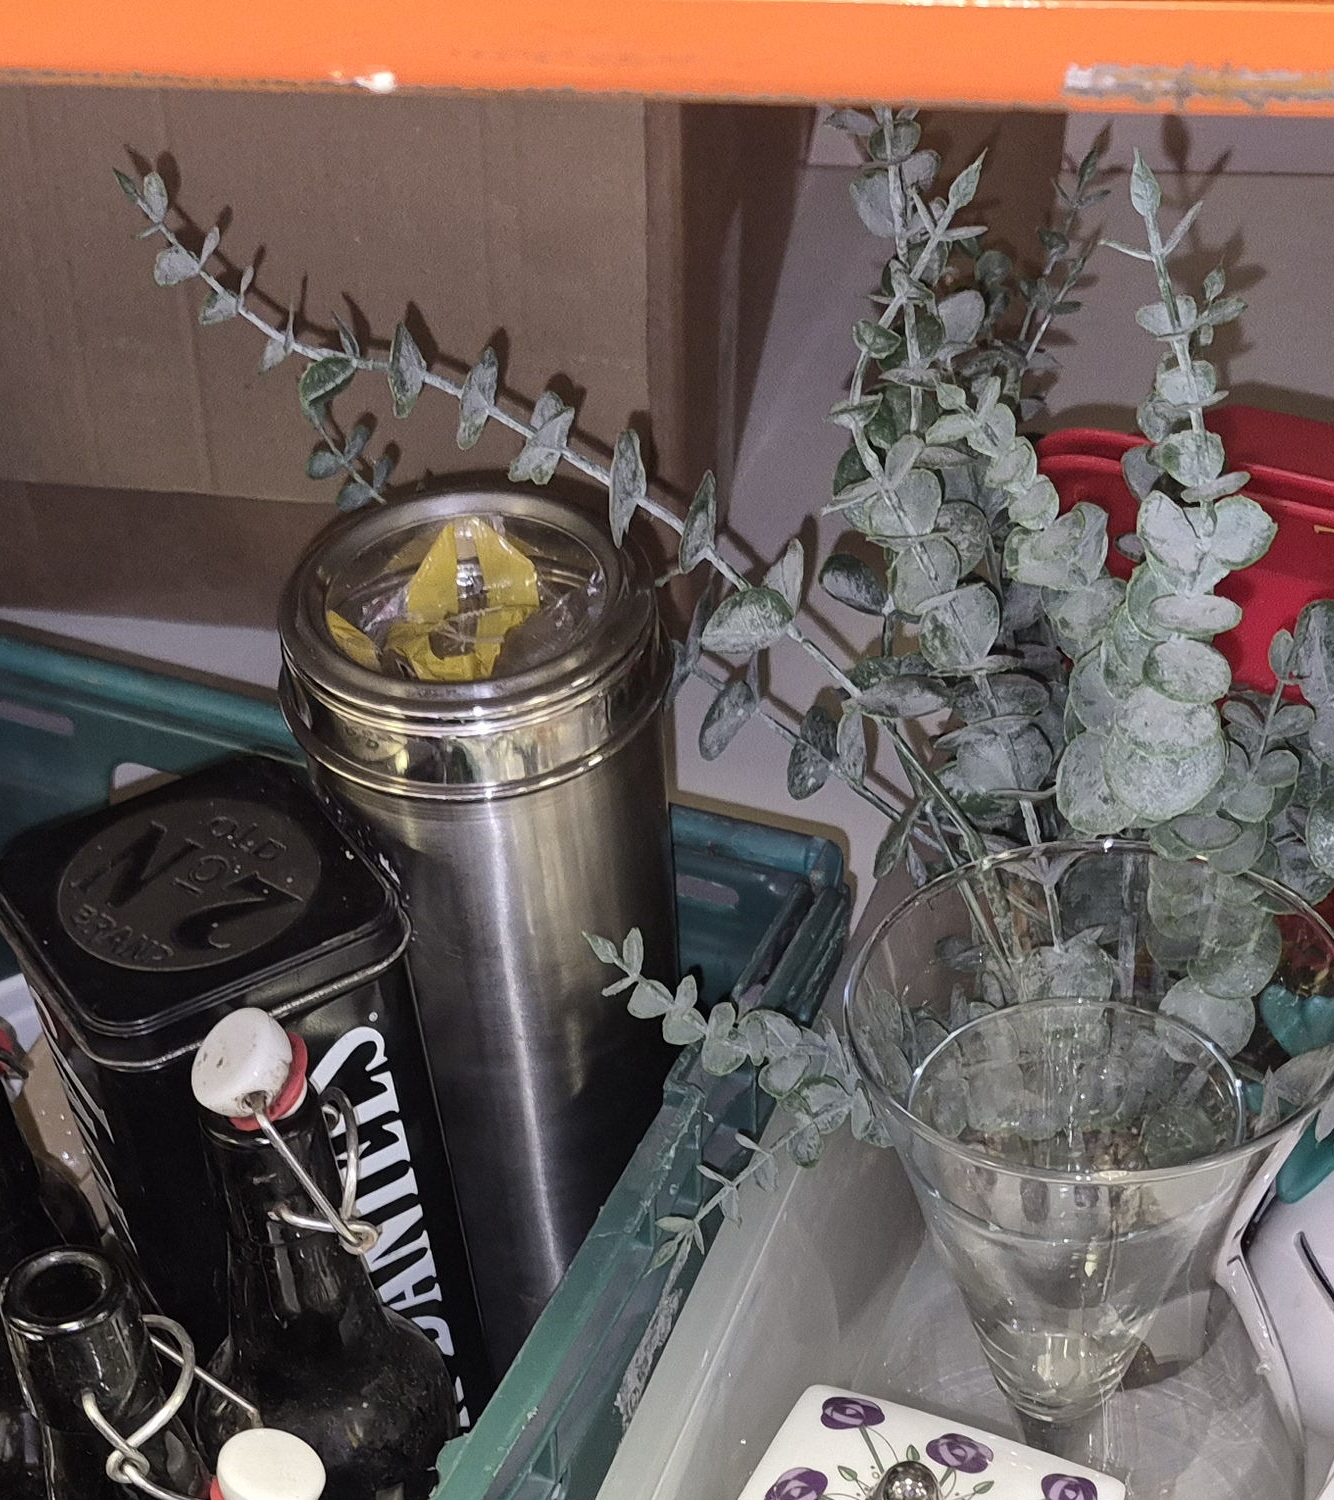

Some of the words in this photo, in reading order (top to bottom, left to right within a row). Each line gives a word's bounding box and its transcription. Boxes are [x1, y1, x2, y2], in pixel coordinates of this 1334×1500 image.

[207, 815, 286, 861] OLD
[71, 904, 174, 967] BRAND
[175, 868, 305, 951] 7
